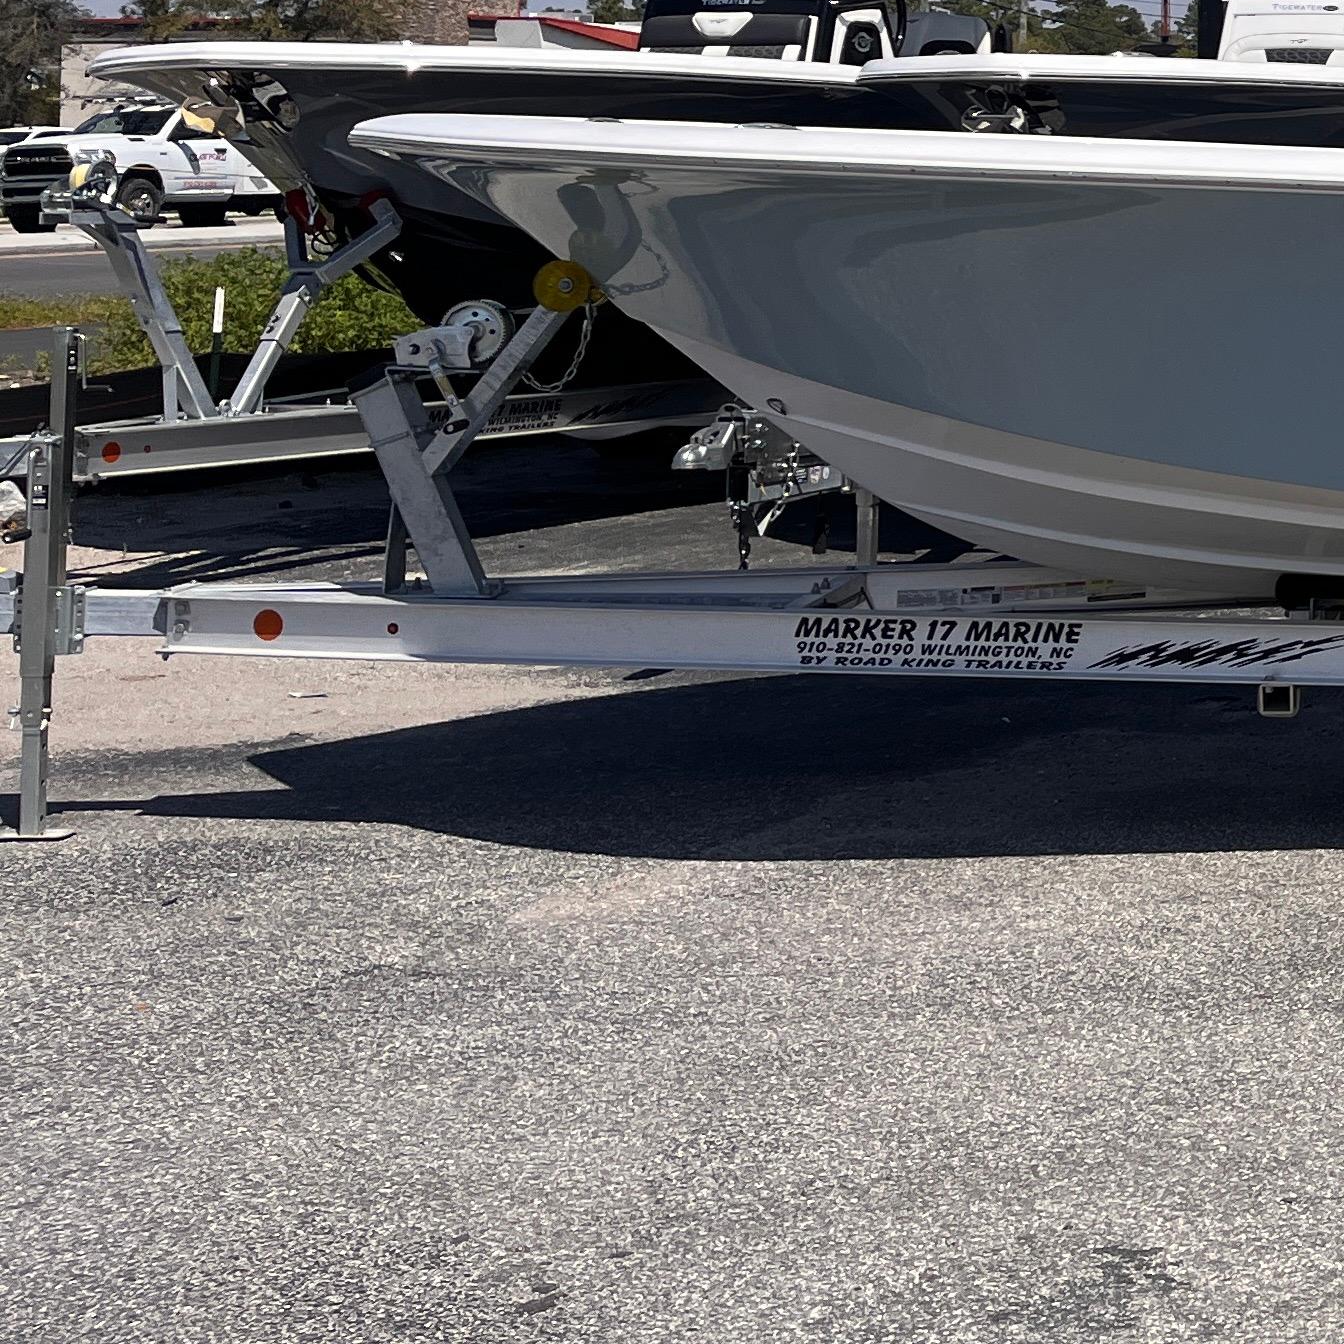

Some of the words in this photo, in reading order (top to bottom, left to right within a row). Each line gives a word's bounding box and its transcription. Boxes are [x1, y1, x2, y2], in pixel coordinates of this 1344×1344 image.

[794, 616, 917, 642] MARKER
[926, 619, 958, 641] 17
[964, 620, 1083, 645] MARINE
[796, 640, 914, 656] 910-821-0190
[920, 643, 1042, 660] WILMINGTON,
[1051, 646, 1074, 659] NC
[800, 655, 827, 666] BY
[834, 656, 893, 667] ROAD
[900, 657, 955, 669] KING
[963, 659, 1067, 671] TRAILERS
